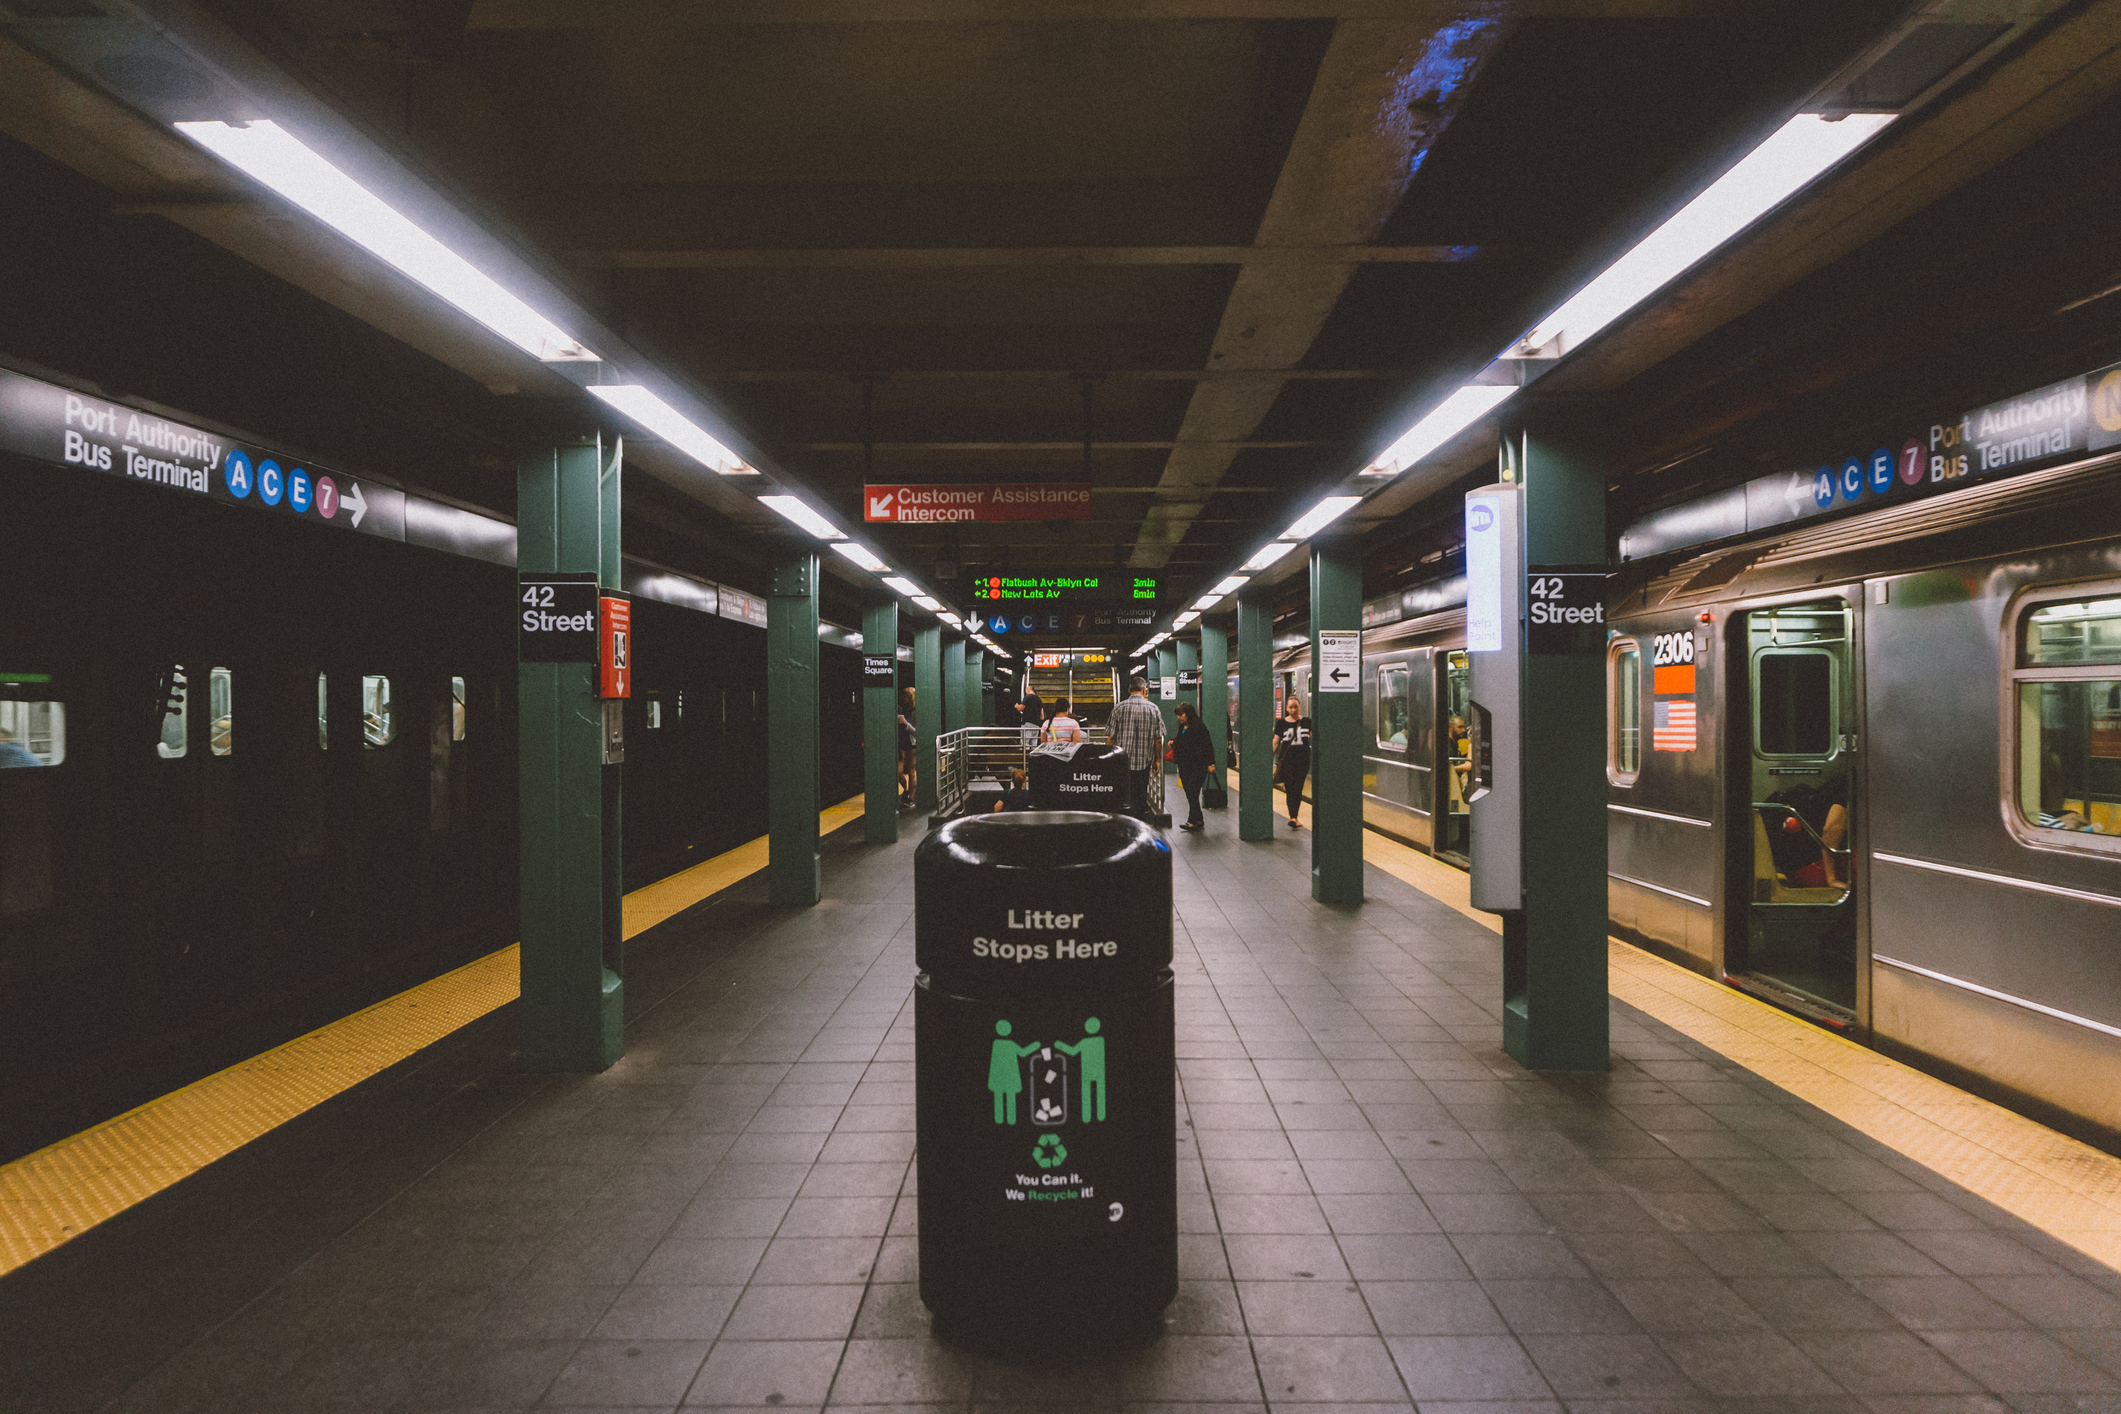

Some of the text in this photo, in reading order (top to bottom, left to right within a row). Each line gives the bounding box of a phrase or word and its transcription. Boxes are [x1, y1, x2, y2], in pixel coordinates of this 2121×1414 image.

[1930, 384, 2087, 451] Port Authority
[65, 394, 332, 509] Port Authority A C E 7
[1818, 418, 2072, 500] A C E 7 Bus Terminal
[65, 430, 209, 492] Bus Terminal
[898, 487, 1090, 504] Customer Assistance
[898, 506, 975, 521] Intercom
[1001, 578, 1037, 587] Flatbush
[1040, 578, 1082, 588] Av-Bklyn
[1133, 578, 1155, 587] 3min
[1530, 578, 1564, 599] 42
[522, 586, 555, 607] 42
[1002, 589, 1021, 598] New
[1023, 589, 1044, 598] Lots
[1046, 589, 1060, 598] Av
[522, 610, 595, 632] Street
[1530, 602, 1604, 624] Street
[994, 615, 1152, 629] A C E 7 Bus Terminal
[1469, 618, 1491, 629] Help
[1469, 632, 1495, 641] Point
[1654, 631, 1693, 665] 2306
[1034, 655, 1057, 666] Exit
[865, 666, 893, 675] Square
[1073, 773, 1101, 781] Litter
[1060, 784, 1113, 793] Stops Here
[1008, 909, 1084, 929] Litter
[973, 937, 1118, 964] Stops Here
[1016, 1173, 1039, 1186] You
[1042, 1174, 1067, 1186] Can
[1005, 1188, 1025, 1201] We
[1028, 1189, 1078, 1202] Recycle
